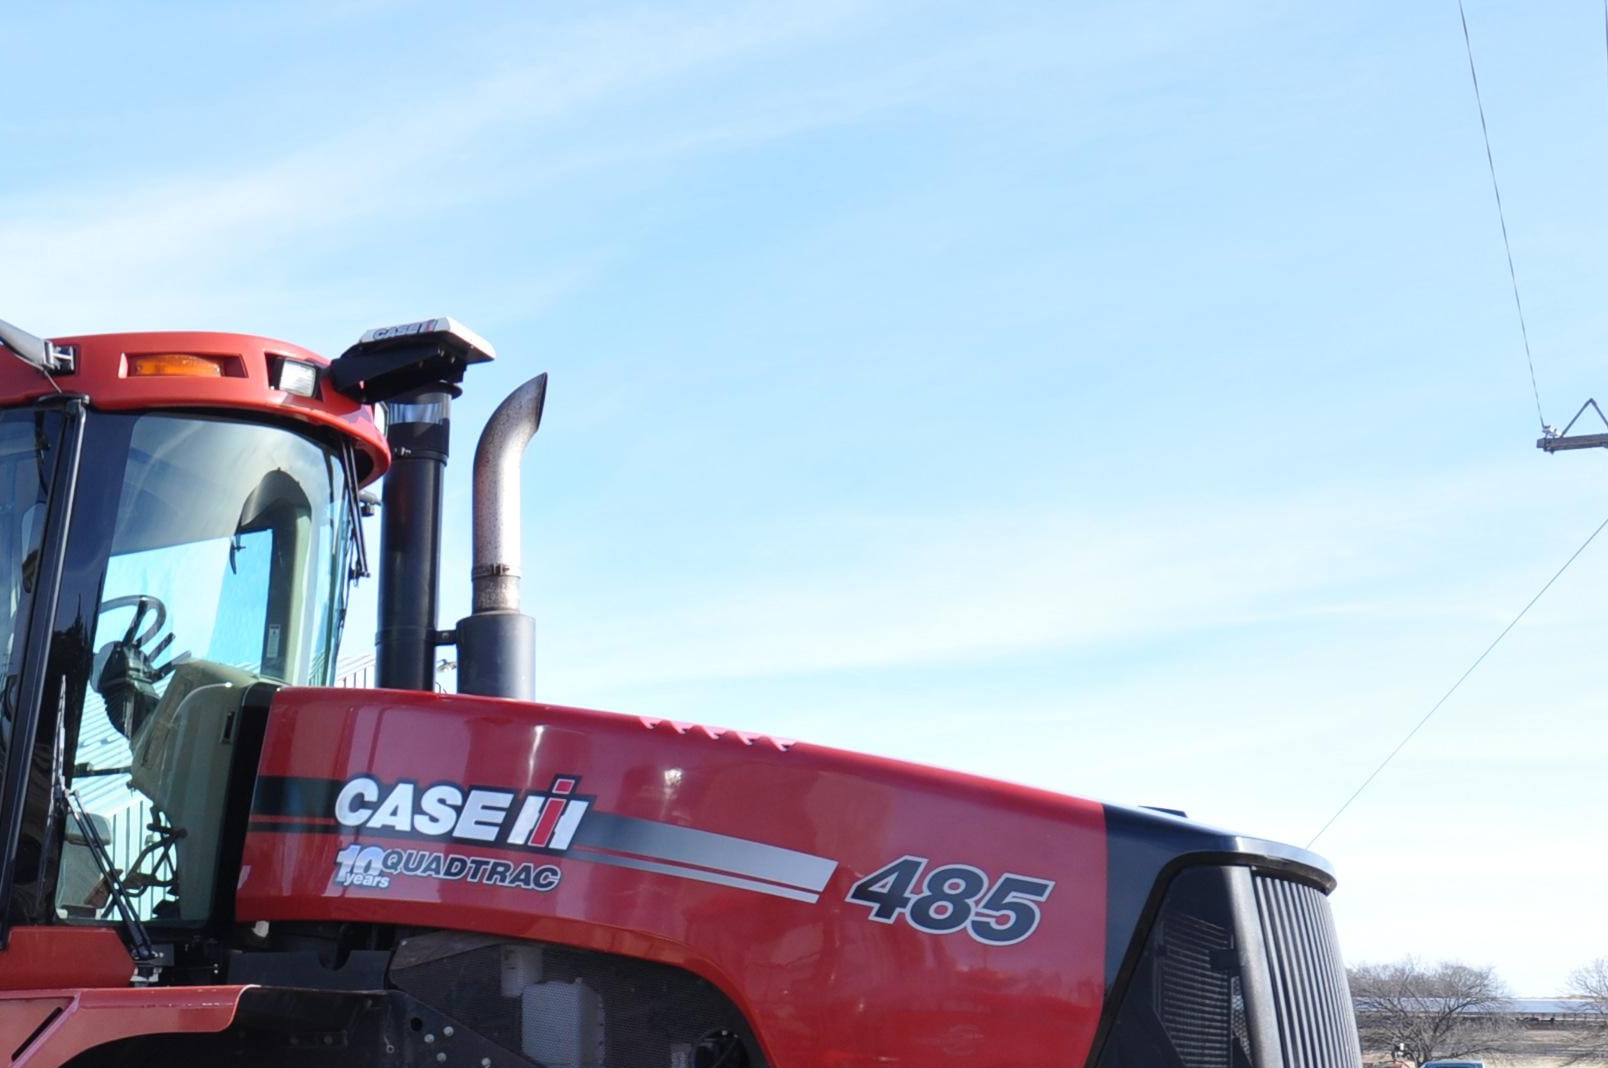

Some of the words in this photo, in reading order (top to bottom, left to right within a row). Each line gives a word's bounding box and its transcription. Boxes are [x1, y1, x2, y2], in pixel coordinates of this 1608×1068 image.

[372, 323, 419, 340] CASE
[335, 777, 514, 842] CASE
[336, 845, 385, 884] 10
[343, 870, 390, 888] years
[382, 848, 561, 891] QUADTRAC
[844, 854, 1056, 946] 485
